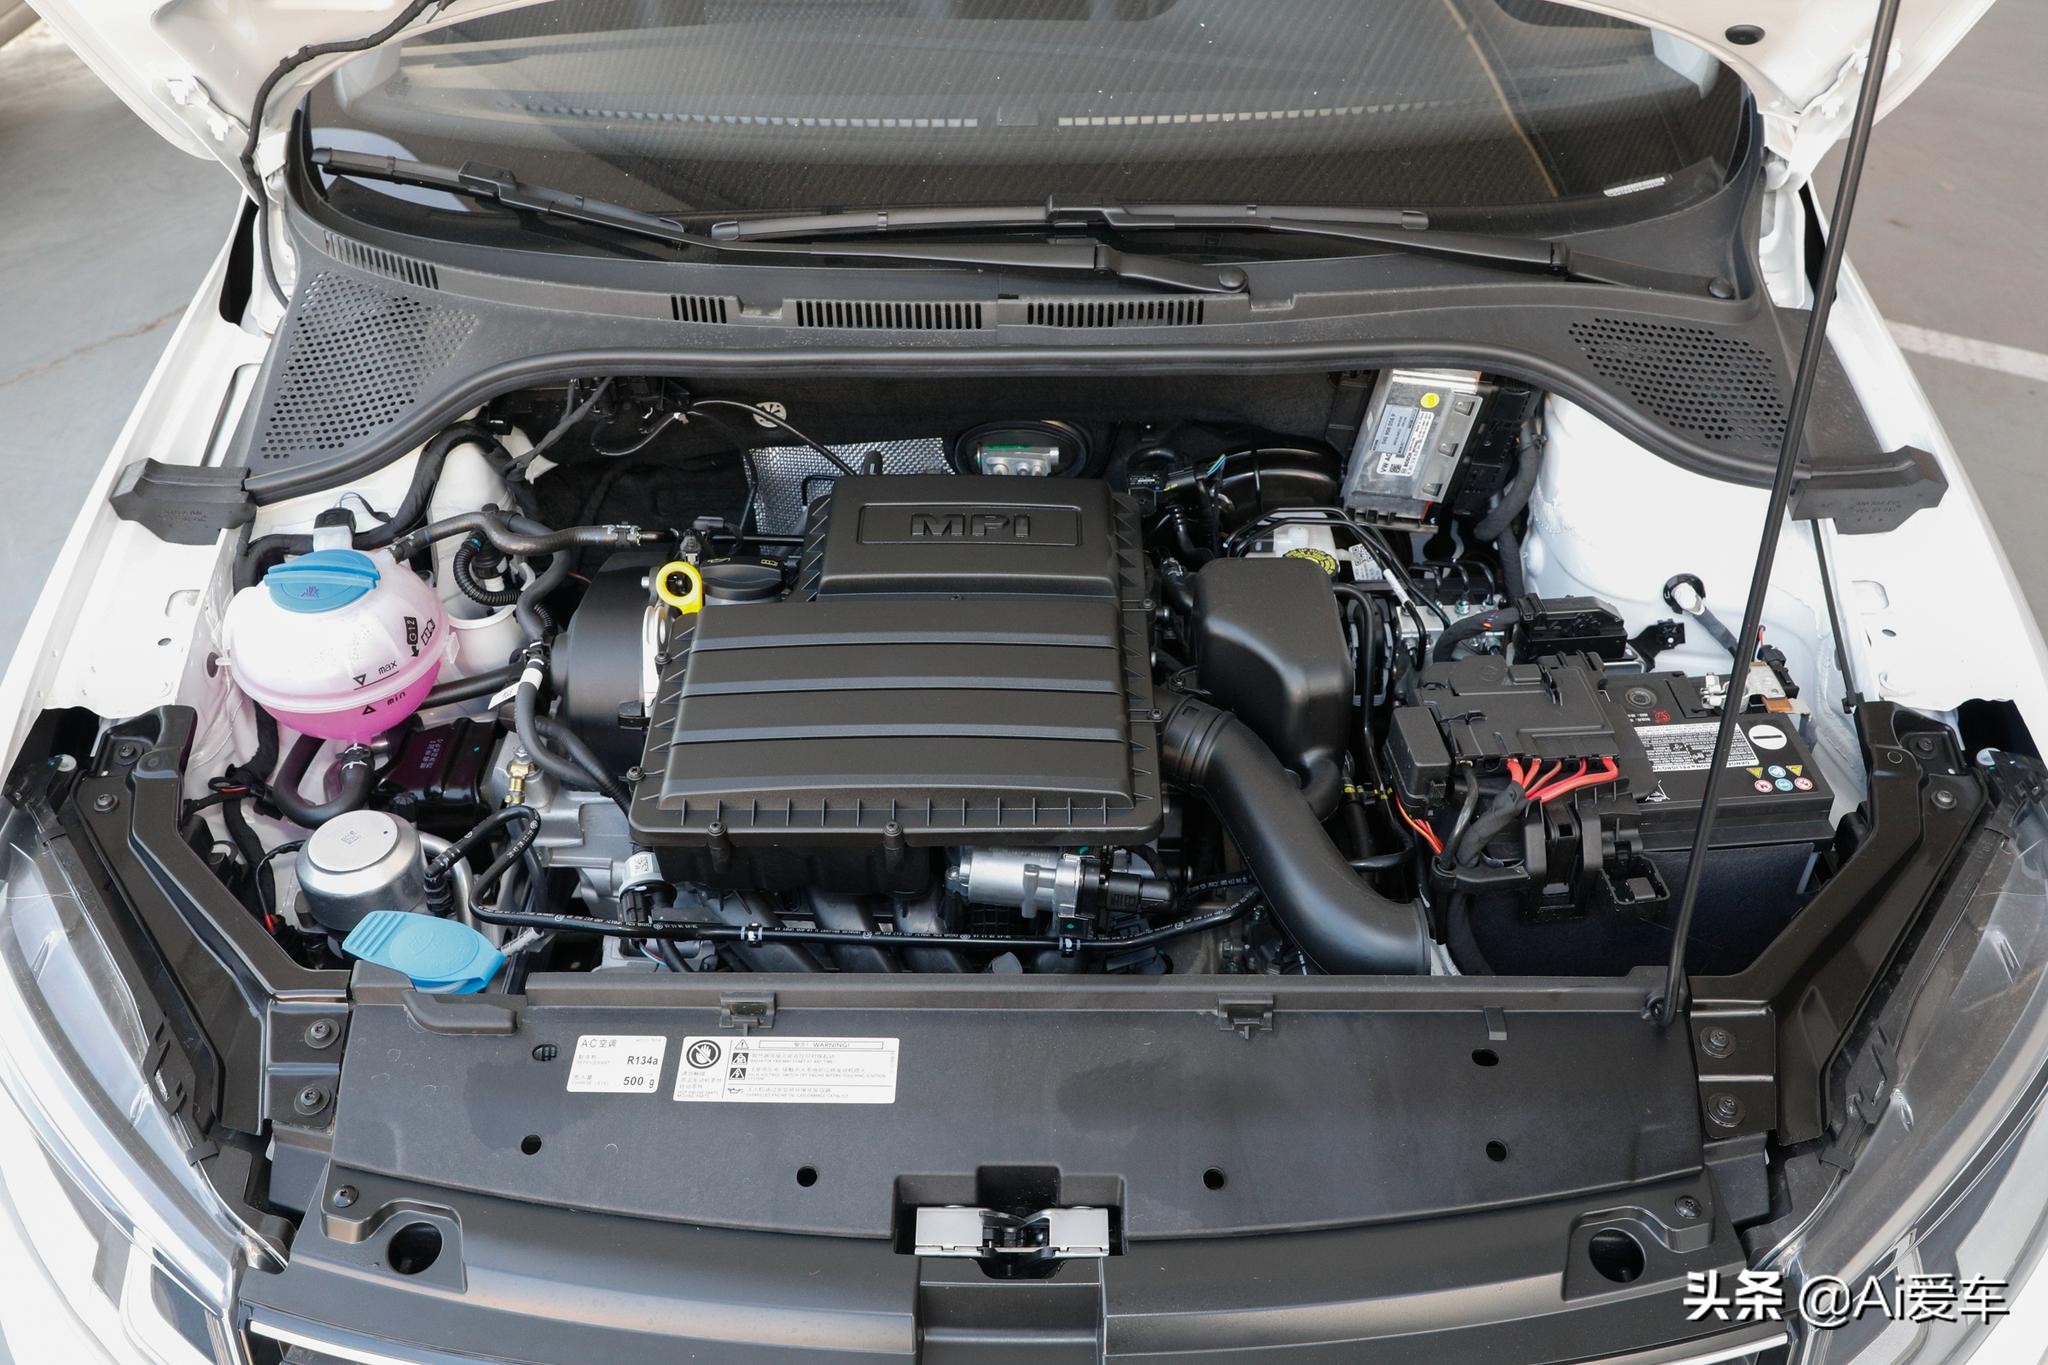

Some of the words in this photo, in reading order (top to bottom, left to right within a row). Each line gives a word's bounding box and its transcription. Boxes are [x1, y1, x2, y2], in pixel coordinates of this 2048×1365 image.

[911, 513, 1030, 537] MPI
[408, 619, 417, 642] G12
[378, 660, 398, 675] max
[387, 691, 406, 706] min
[627, 1056, 658, 1065] R134a
[624, 1076, 644, 1086] 500
[649, 1078, 655, 1089] g
